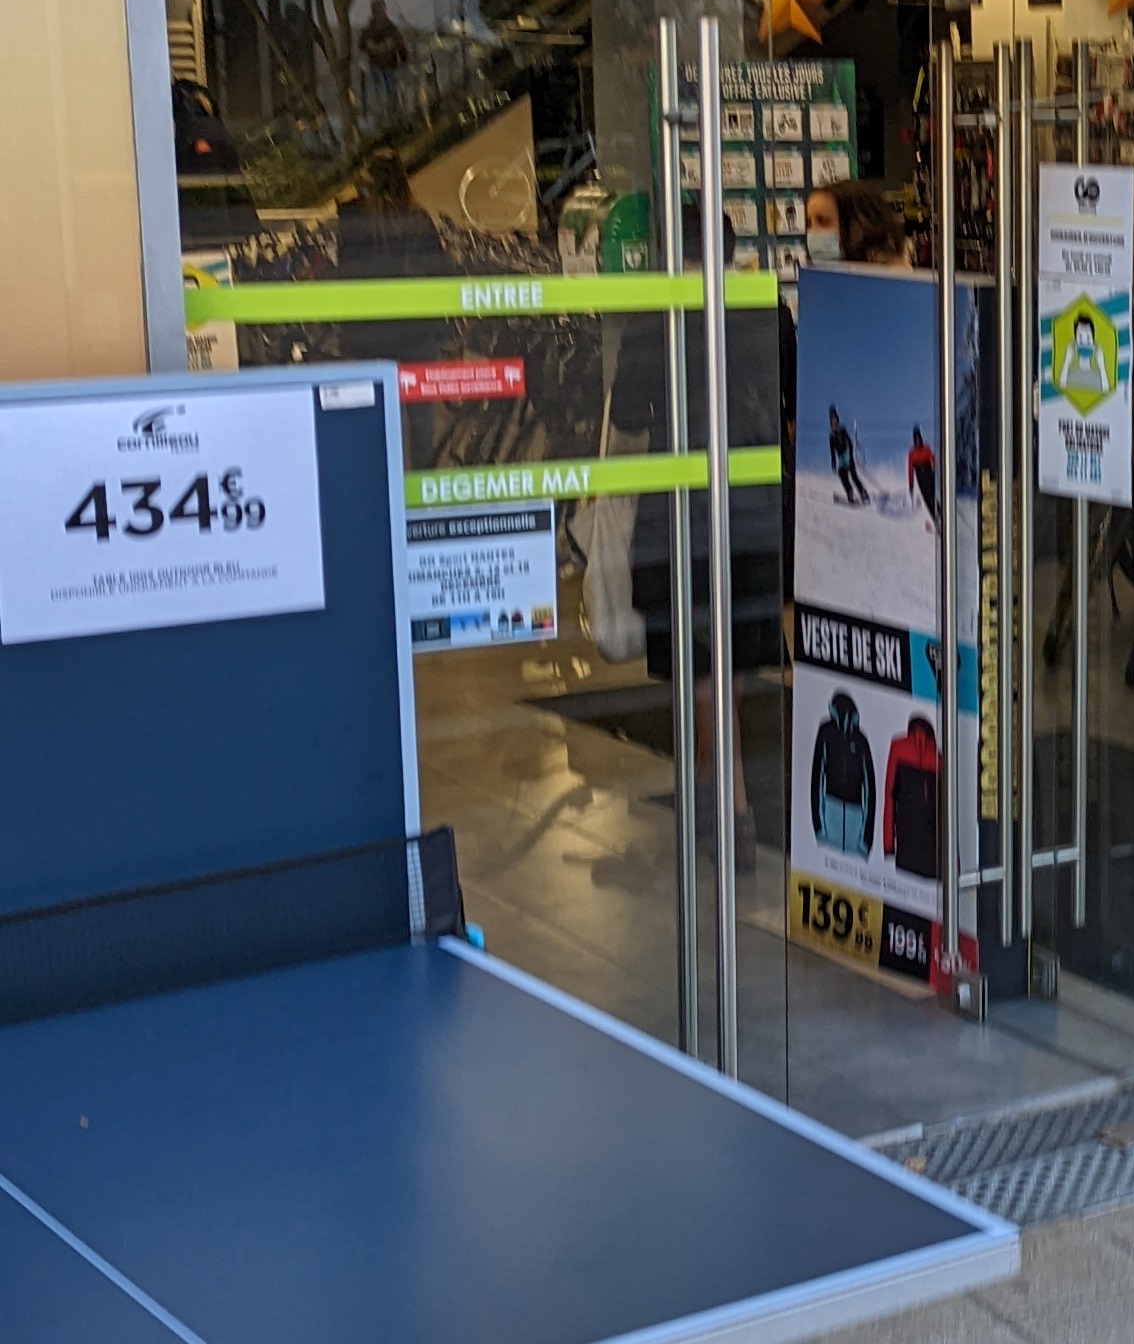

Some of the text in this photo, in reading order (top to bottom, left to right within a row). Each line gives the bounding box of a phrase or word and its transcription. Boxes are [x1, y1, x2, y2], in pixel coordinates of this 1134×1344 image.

[461, 280, 543, 312] ENTREE
[421, 464, 592, 504] DEGEMER MAT
[801, 611, 902, 683] VESTE DE SKI
